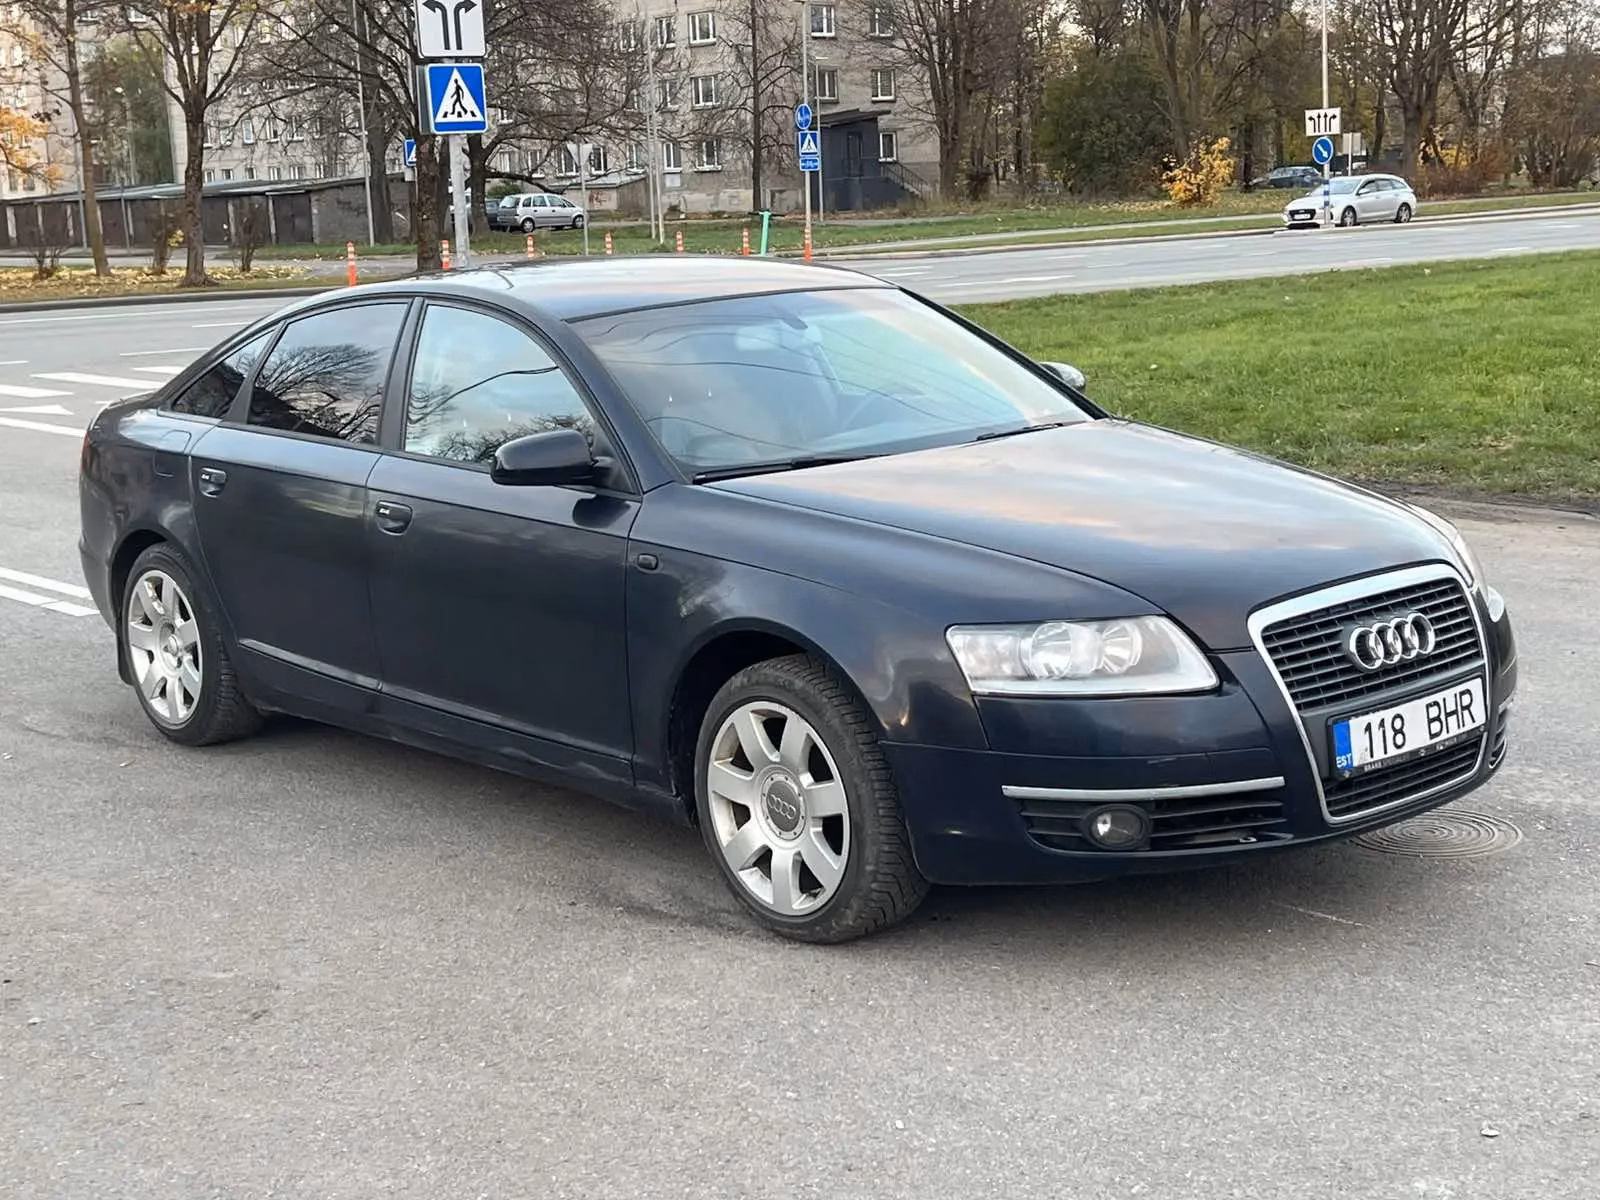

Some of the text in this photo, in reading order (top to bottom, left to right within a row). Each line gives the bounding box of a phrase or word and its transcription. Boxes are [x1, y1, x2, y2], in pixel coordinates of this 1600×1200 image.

[1364, 688, 1476, 759] 118 BHR
[1336, 753, 1352, 768] EST
